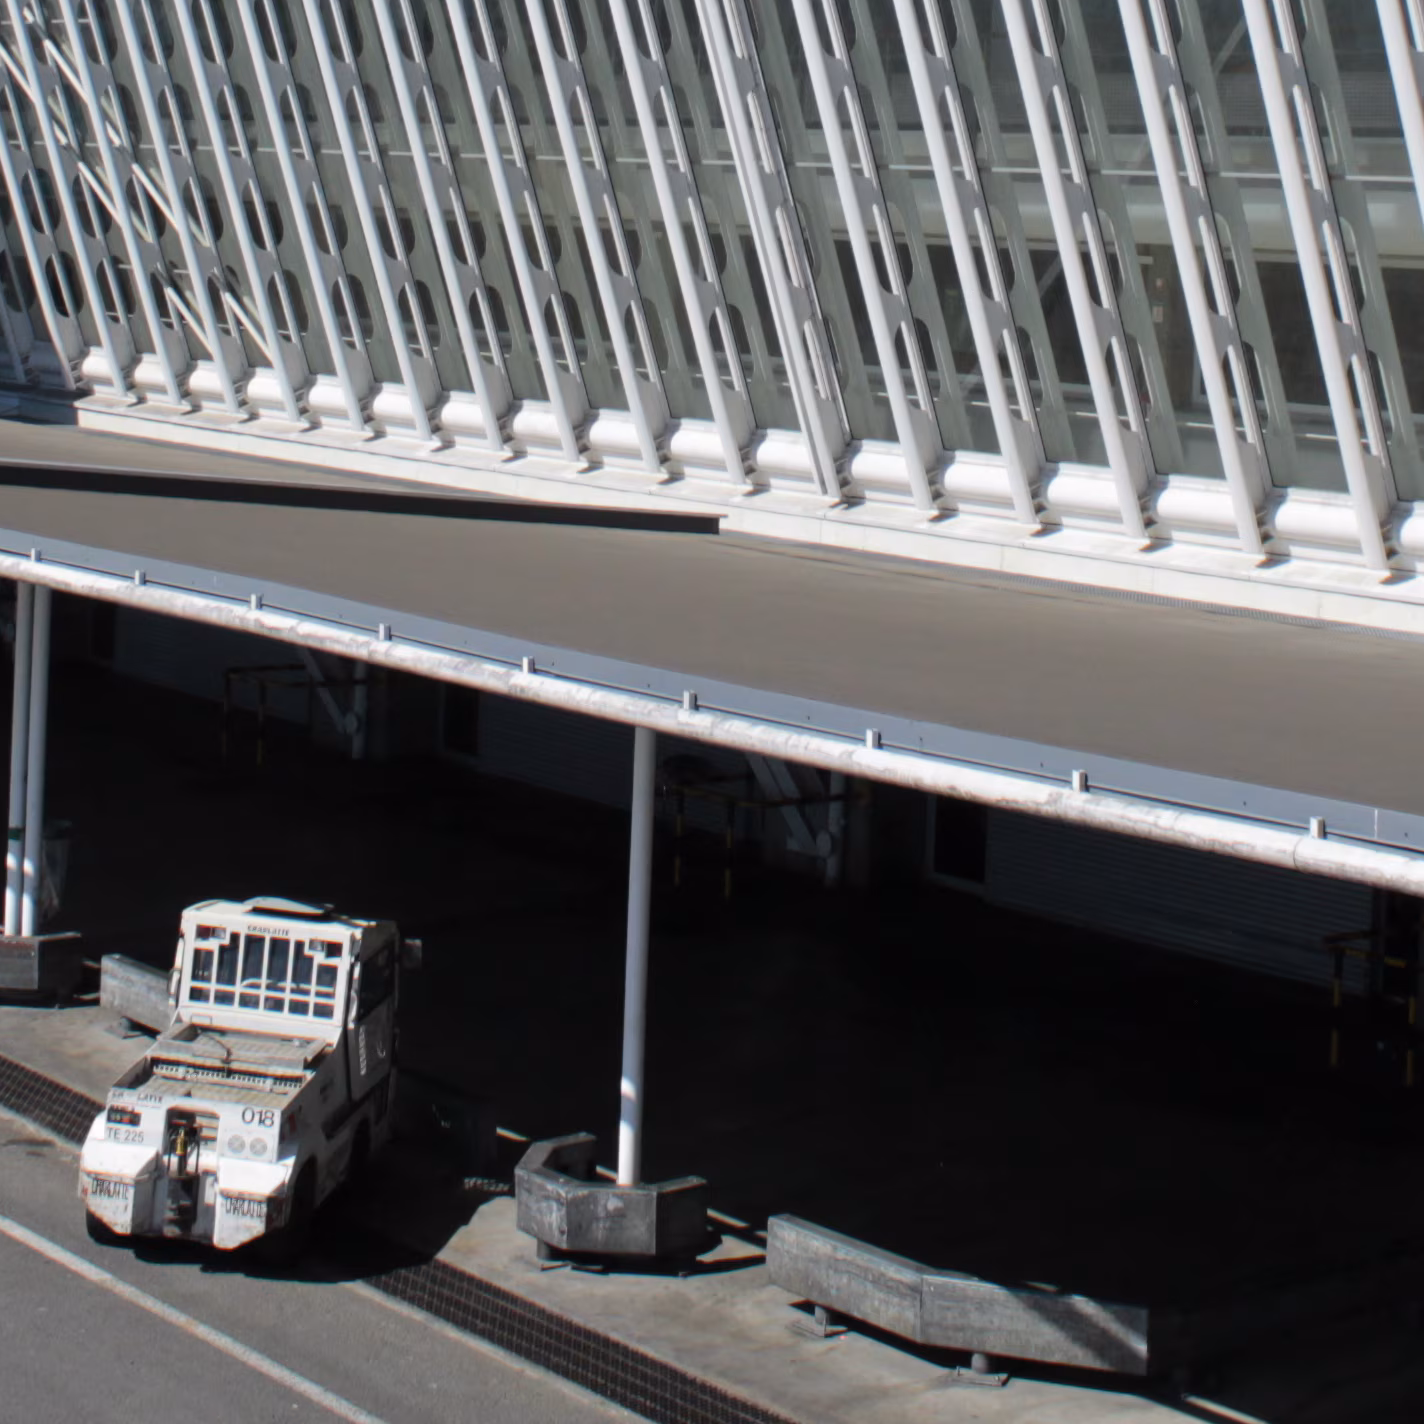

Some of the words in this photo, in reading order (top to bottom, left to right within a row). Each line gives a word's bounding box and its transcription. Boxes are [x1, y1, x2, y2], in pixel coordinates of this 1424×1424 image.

[241, 1106, 275, 1127] 018
[106, 1128, 121, 1141] TE
[123, 1129, 145, 1143] 225
